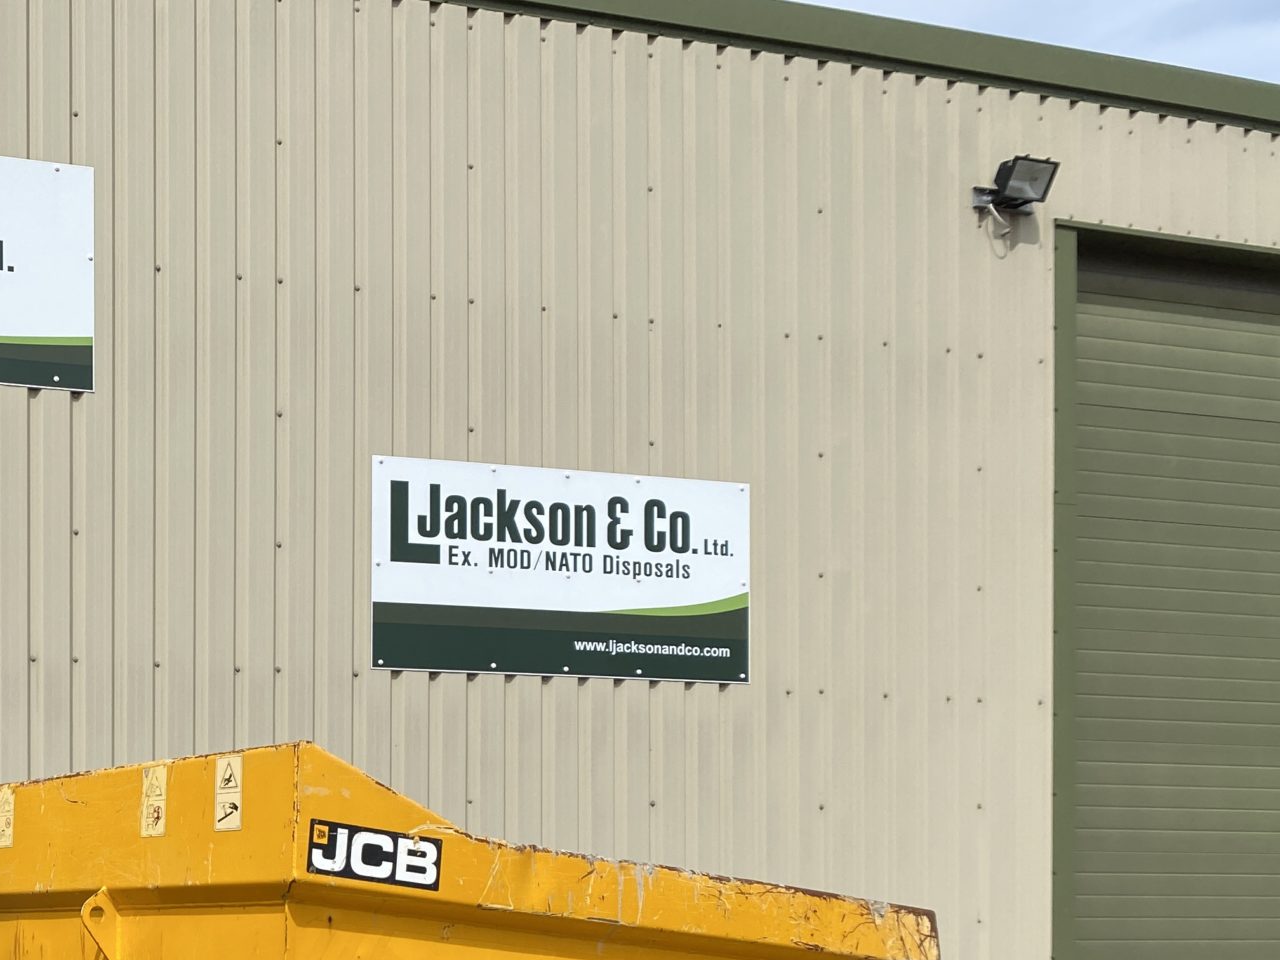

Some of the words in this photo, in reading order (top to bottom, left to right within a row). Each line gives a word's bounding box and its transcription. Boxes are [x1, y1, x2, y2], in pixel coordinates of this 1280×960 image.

[607, 496, 634, 551] &
[644, 498, 698, 555] Co.
[703, 538, 735, 558] Ltd.
[448, 545, 479, 567] Ex.
[488, 547, 593, 573] MOD/NATO
[603, 554, 691, 580] Disposals
[574, 640, 731, 658] www.ljacksonandco.com
[311, 827, 439, 885] JCB
